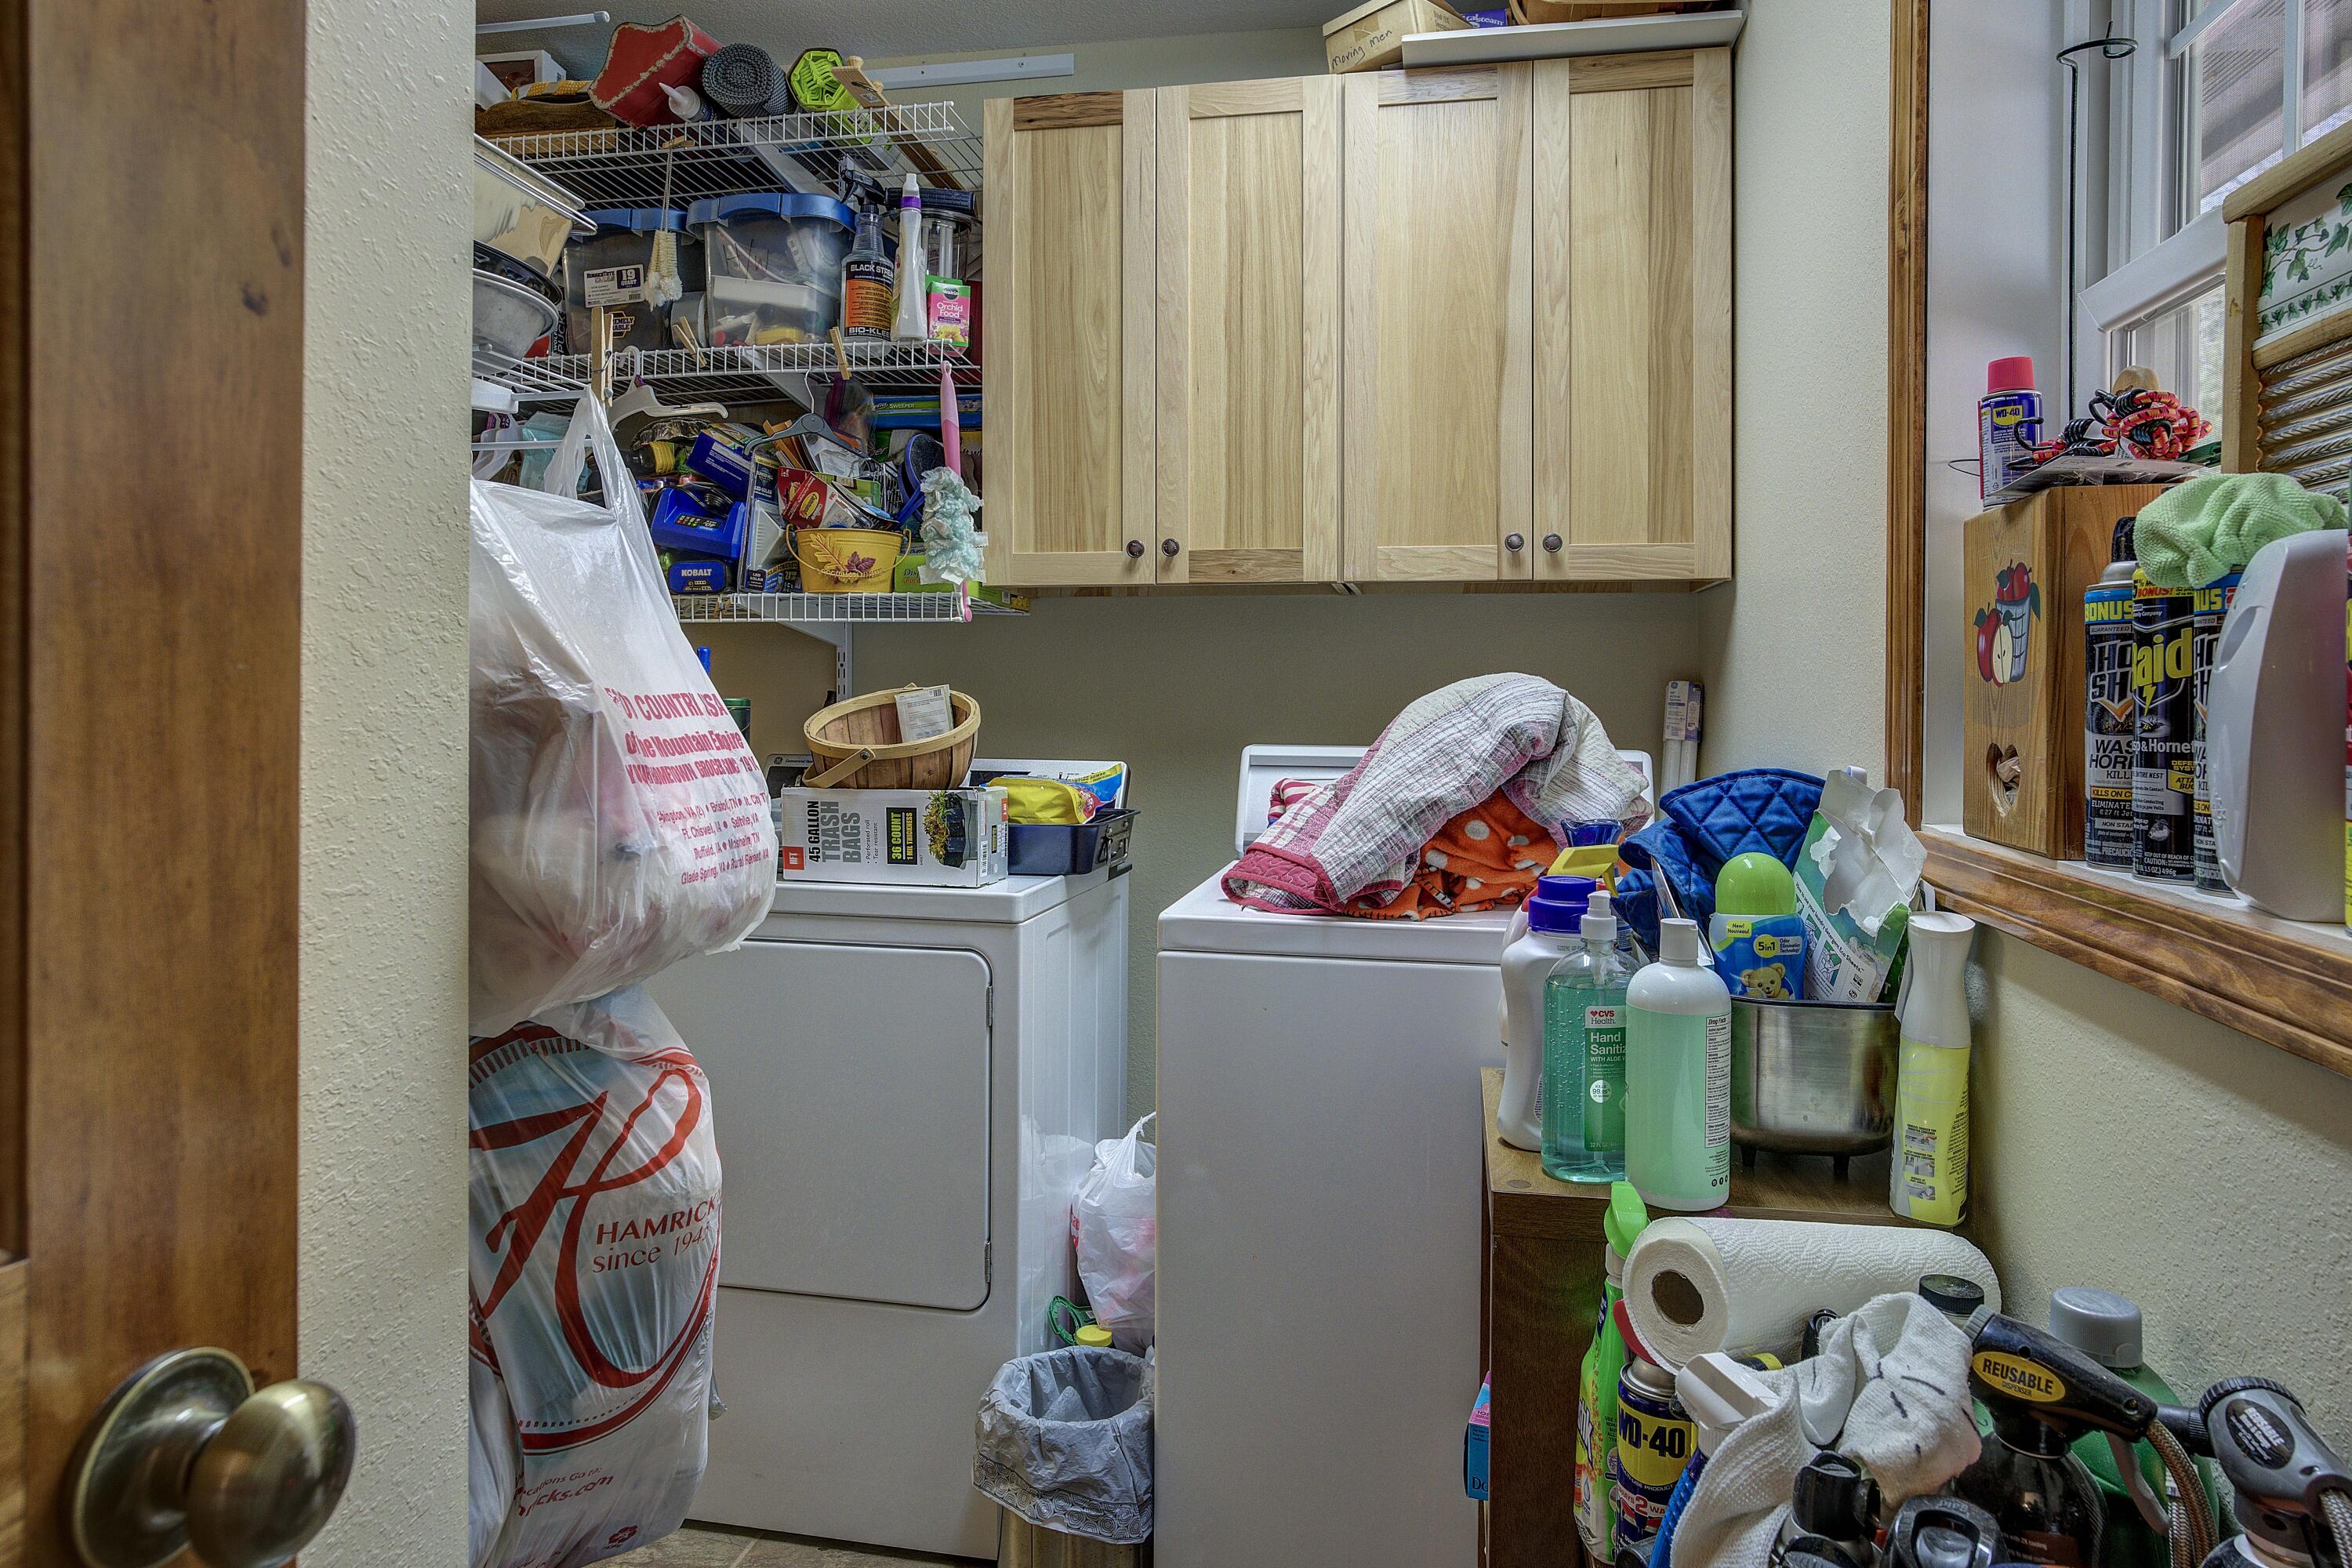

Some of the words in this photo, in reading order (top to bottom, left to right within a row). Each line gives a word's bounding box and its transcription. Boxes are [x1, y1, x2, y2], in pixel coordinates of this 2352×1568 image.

[851, 263, 875, 272] BLACK
[622, 269, 636, 281] 19
[937, 302, 964, 312] Orchid
[940, 309, 960, 318] Food
[1994, 408, 2020, 419] WD-40
[681, 568, 712, 577] KOBALT
[2084, 601, 2132, 623] BONUS
[2092, 789, 2109, 797] KILLS
[807, 800, 820, 844] GALLON
[891, 812, 902, 845] COUNT
[820, 801, 841, 863] TRASH
[840, 812, 862, 863] BAGS
[789, 852, 798, 865] HFT
[808, 847, 821, 863] 45
[891, 846, 902, 860] 36
[2144, 857, 2168, 866] CAUTION:
[681, 869, 699, 885] Glade
[2161, 868, 2177, 877] 496g
[1758, 941, 1776, 951] 5in1
[1590, 1031, 1621, 1043] Hand
[593, 1247, 662, 1273] since
[1982, 1357, 2054, 1396] REUSABLE
[2002, 1381, 2033, 1397] DISPENSER
[2244, 1406, 2285, 1447] REUSABLE
[569, 1471, 586, 1482] Go
[1635, 1495, 1649, 1516] 2
[1650, 1506, 1666, 1515] WA
